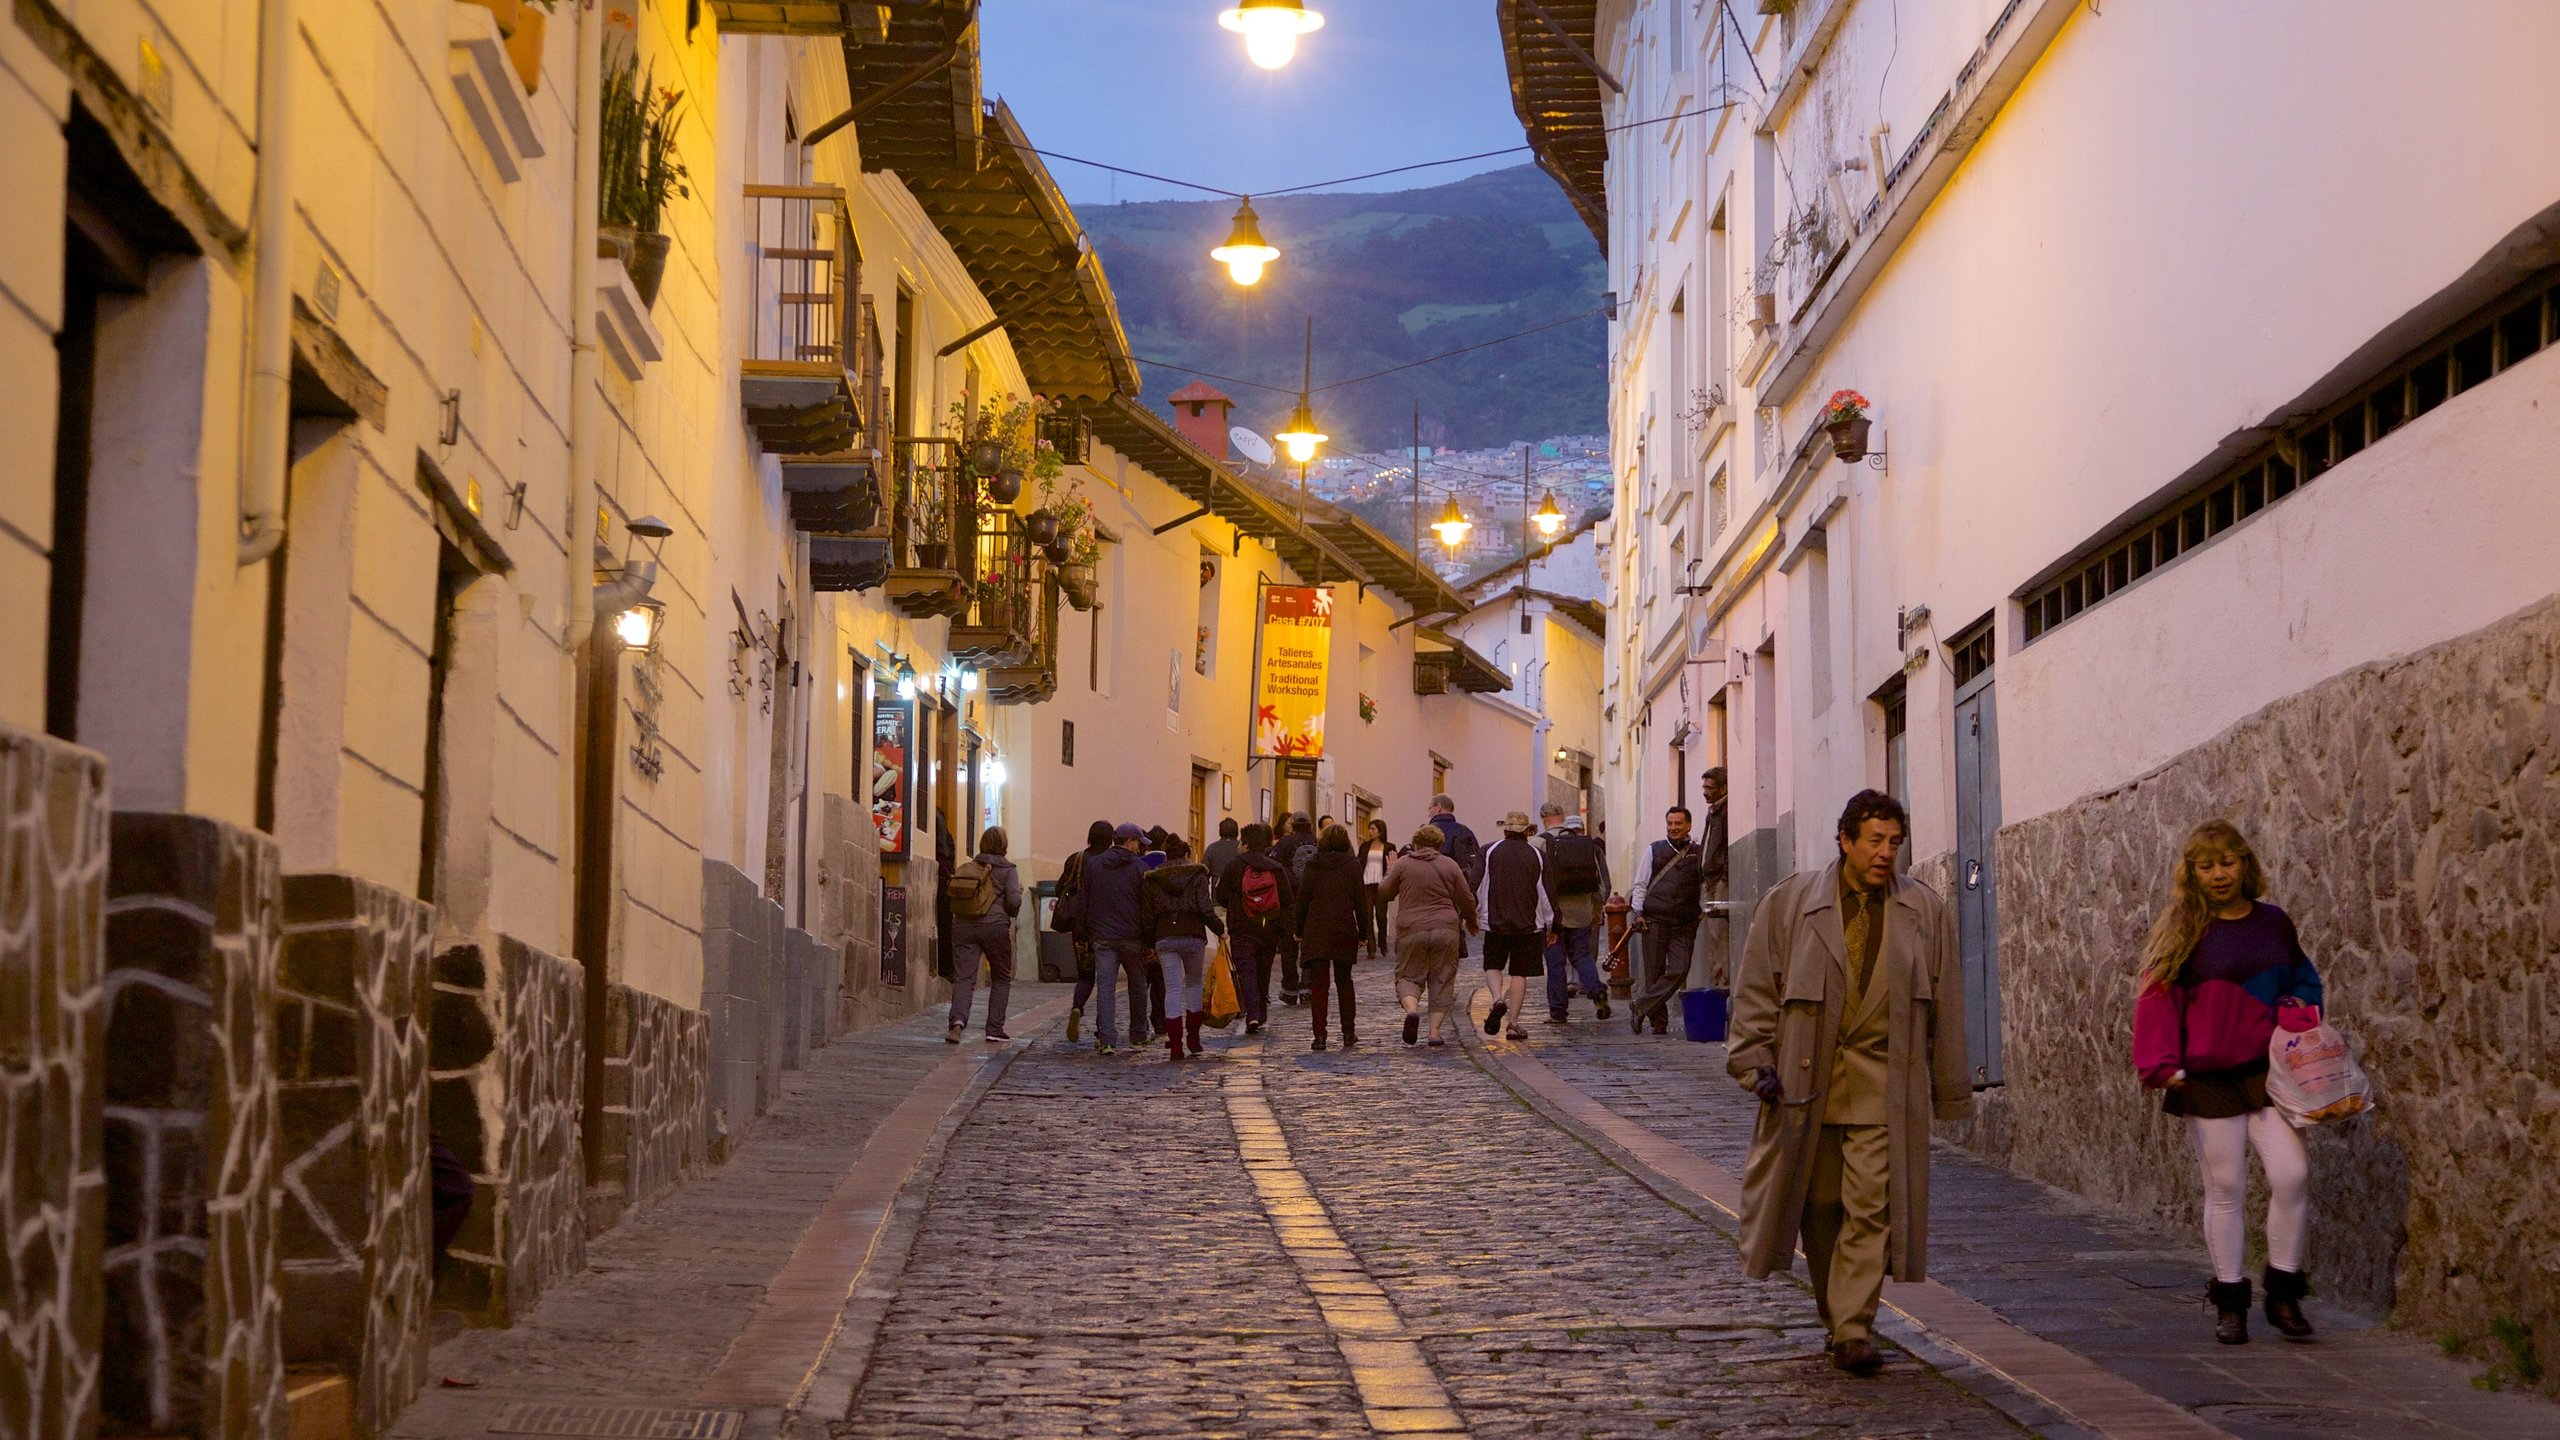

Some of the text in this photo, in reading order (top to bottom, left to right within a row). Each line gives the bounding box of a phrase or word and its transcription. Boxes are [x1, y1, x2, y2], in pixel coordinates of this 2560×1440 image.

[1269, 613, 1325, 627] Casa #707
[1278, 647, 1313, 658] Talleres
[1267, 658, 1322, 669] Artesanales
[1270, 673, 1318, 685] Traditional
[1267, 685, 1319, 697] Workshops
